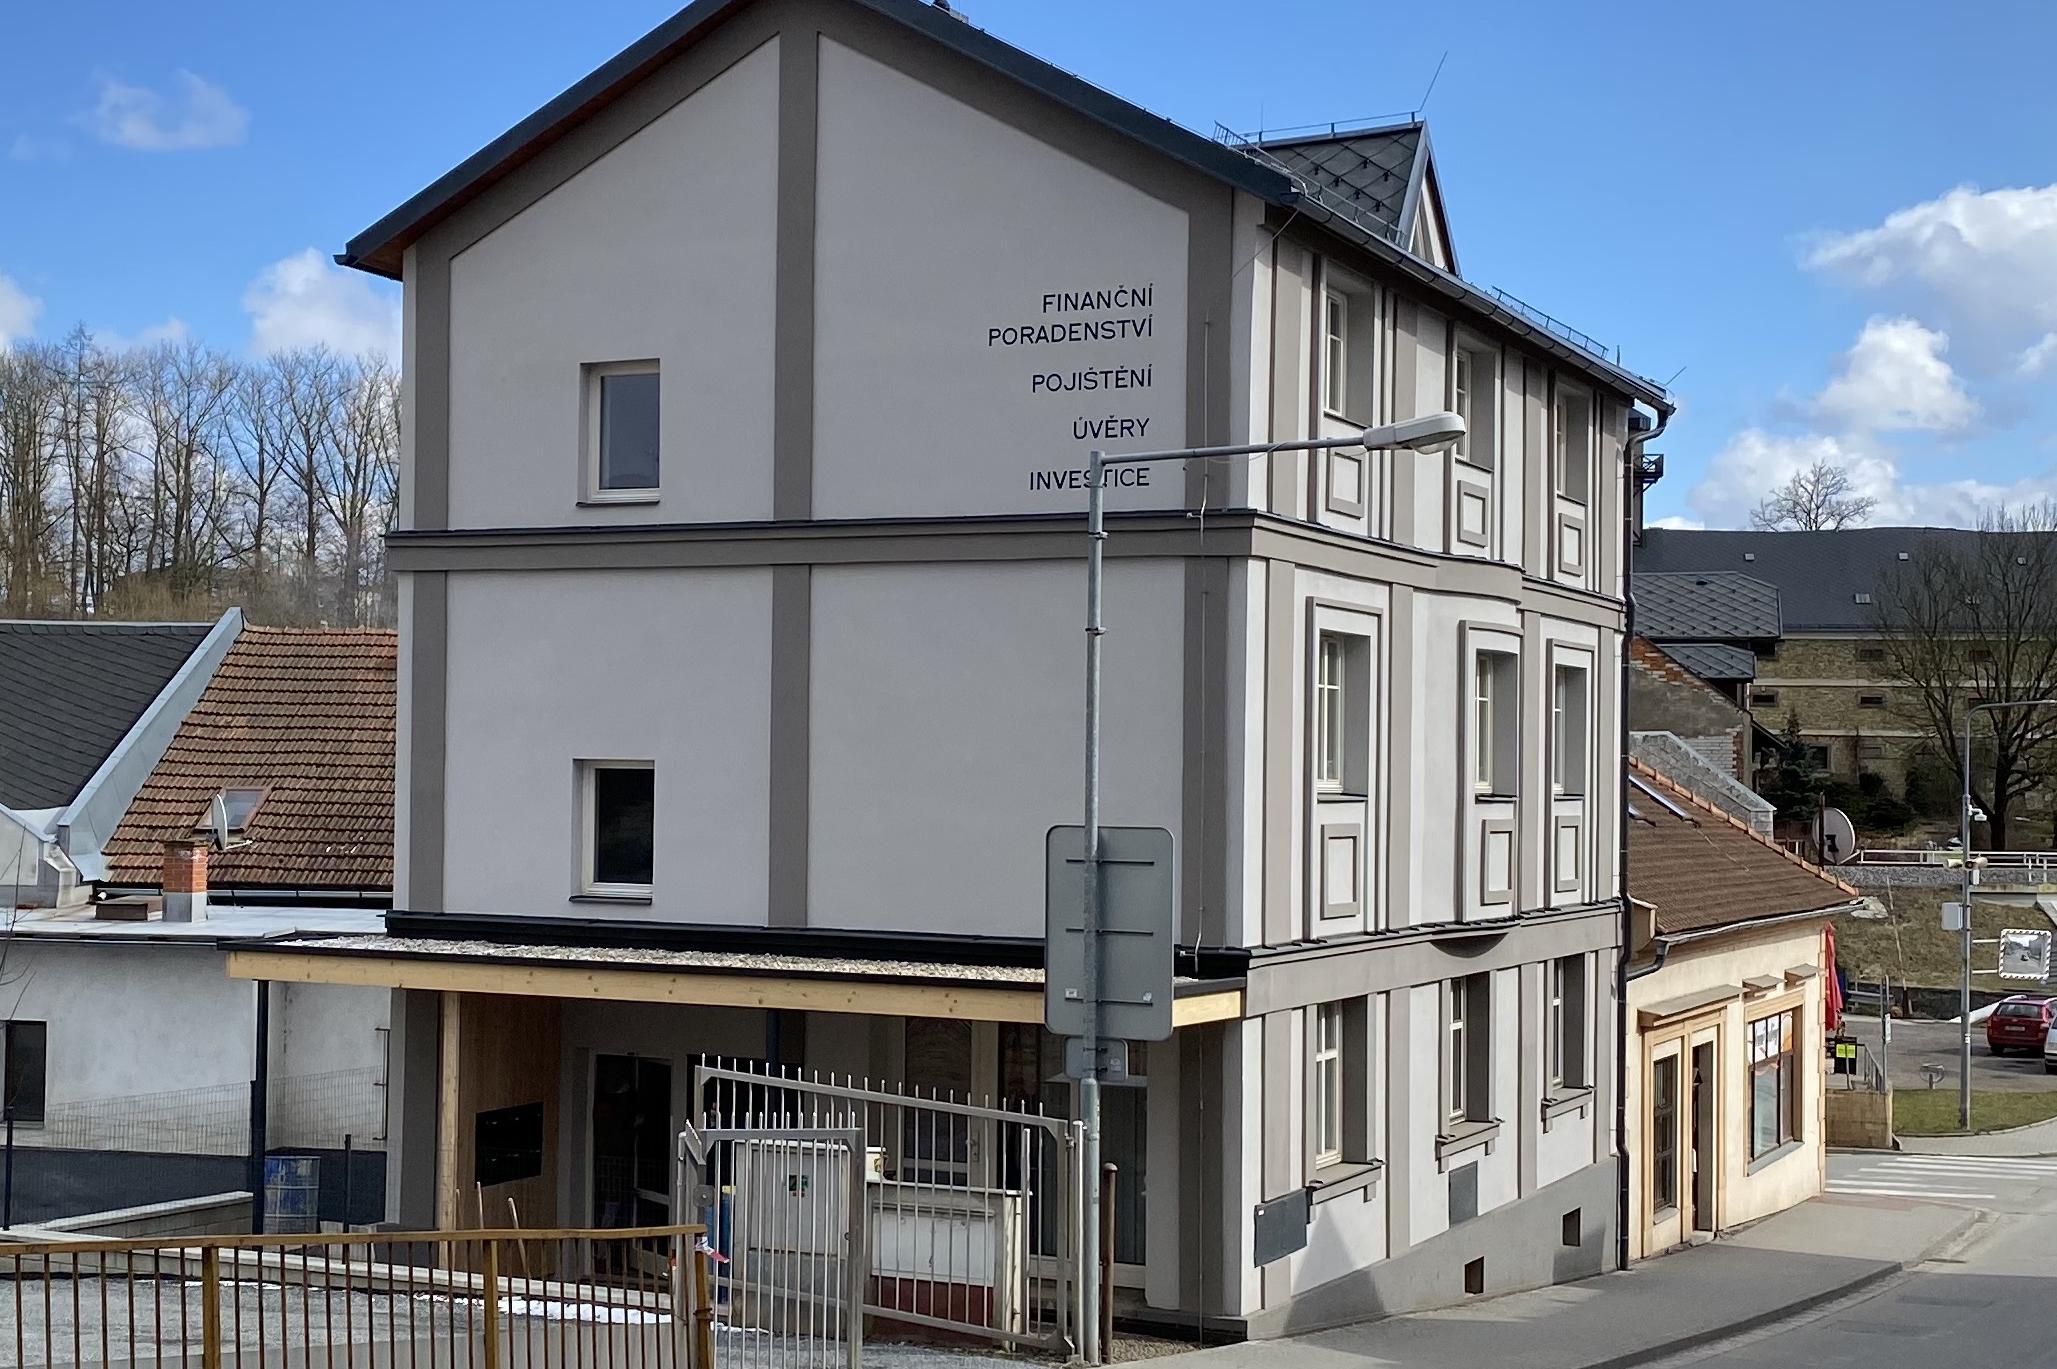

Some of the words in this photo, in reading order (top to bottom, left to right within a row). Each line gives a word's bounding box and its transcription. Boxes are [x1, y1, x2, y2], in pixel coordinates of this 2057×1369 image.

[1042, 283, 1154, 314] FINANČNÍ
[988, 313, 1153, 347] PORADENSTVÍ
[1031, 363, 1153, 394] POJIŠTĚNÍ
[1073, 415, 1150, 440] ÚVĚRY
